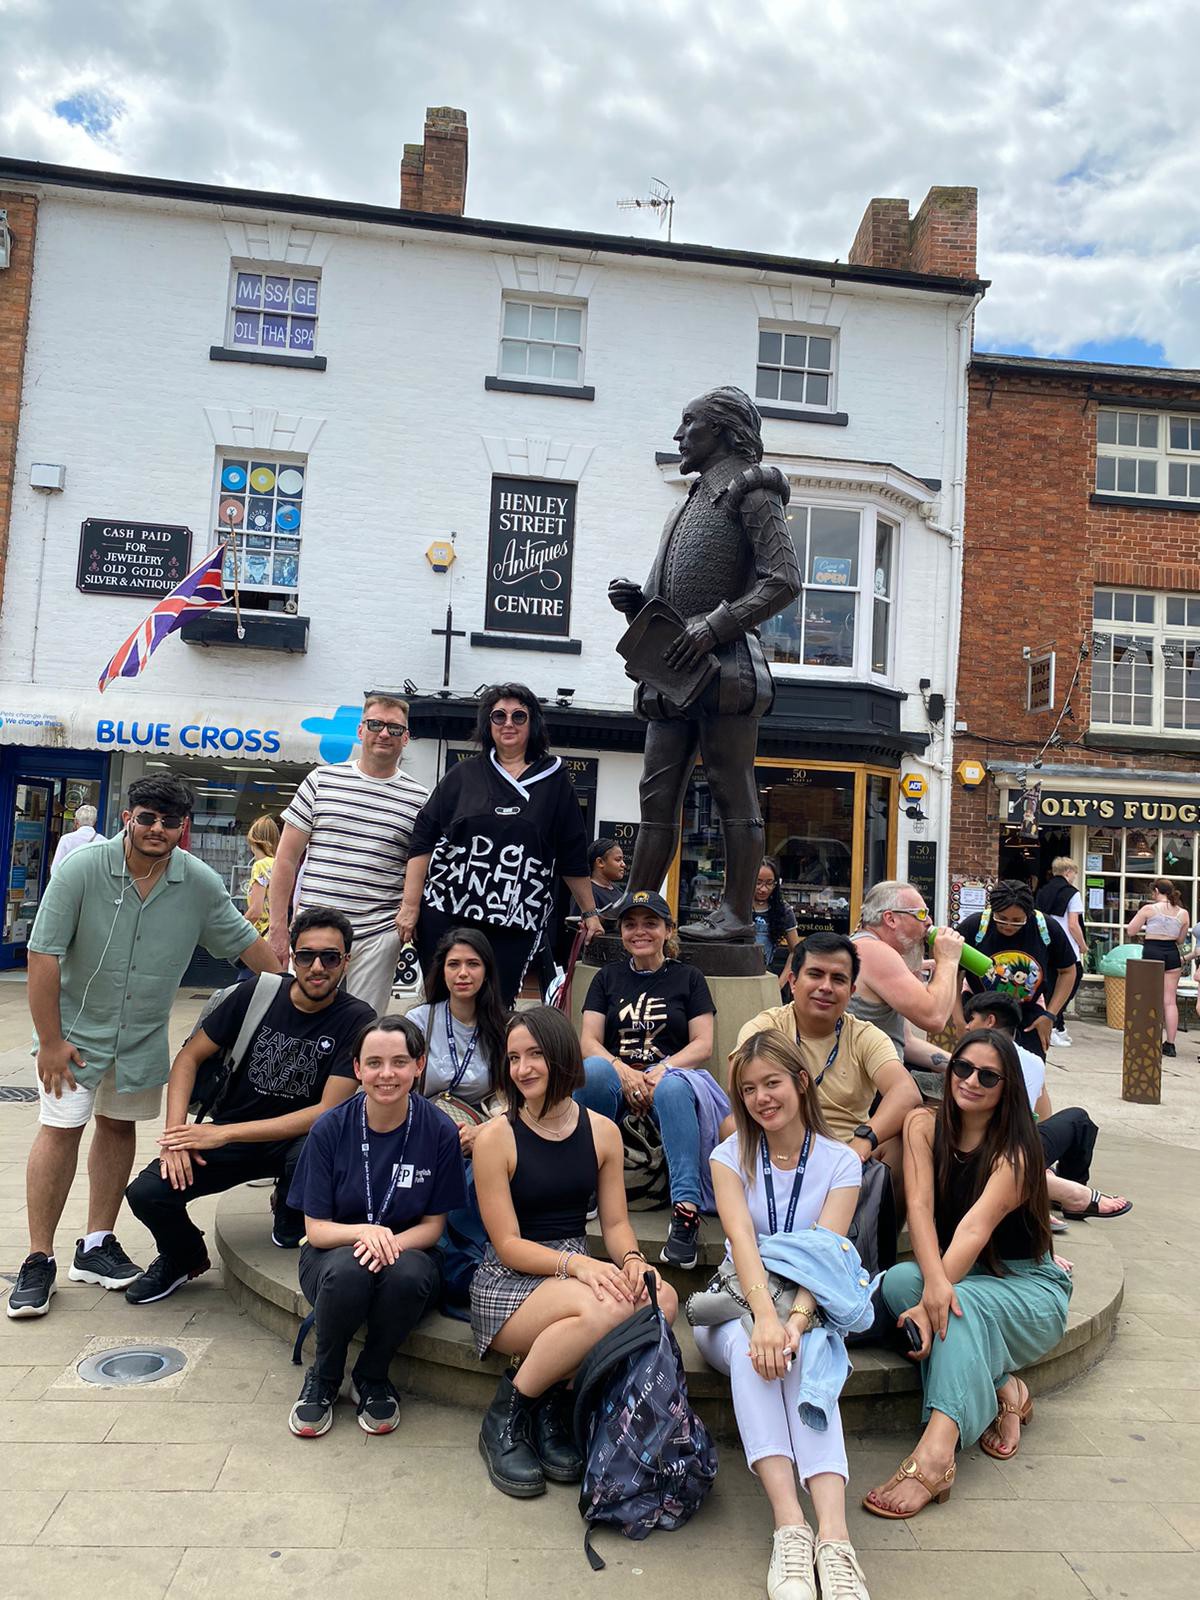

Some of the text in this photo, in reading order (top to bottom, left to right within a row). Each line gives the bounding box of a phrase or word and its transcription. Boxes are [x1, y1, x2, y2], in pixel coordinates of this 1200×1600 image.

[238, 280, 317, 306] MASSAGE
[499, 492, 568, 516] HENLEY
[499, 513, 567, 536] STREET
[103, 527, 172, 542] CASH PAID
[125, 542, 147, 553] FOR
[104, 552, 164, 566] JEWELLERY
[493, 538, 568, 584] Antiques
[103, 563, 164, 578] OLD GOLD
[815, 571, 847, 585] OPEN
[85, 574, 118, 586] SILVER
[119, 577, 128, 586] &
[494, 594, 564, 617] CENTRE
[18, 718, 43, 727] change
[96, 720, 281, 754] BLUE CROSS
[792, 768, 807, 779] 50
[1041, 797, 1200, 824] OLY'S FUDG
[614, 824, 635, 839] 50
[915, 845, 930, 856] 50
[632, 1020, 655, 1030] END
[253, 1041, 318, 1072] CANADA
[249, 1053, 318, 1086] ZAVETTI
[247, 1067, 310, 1097] CANADA
